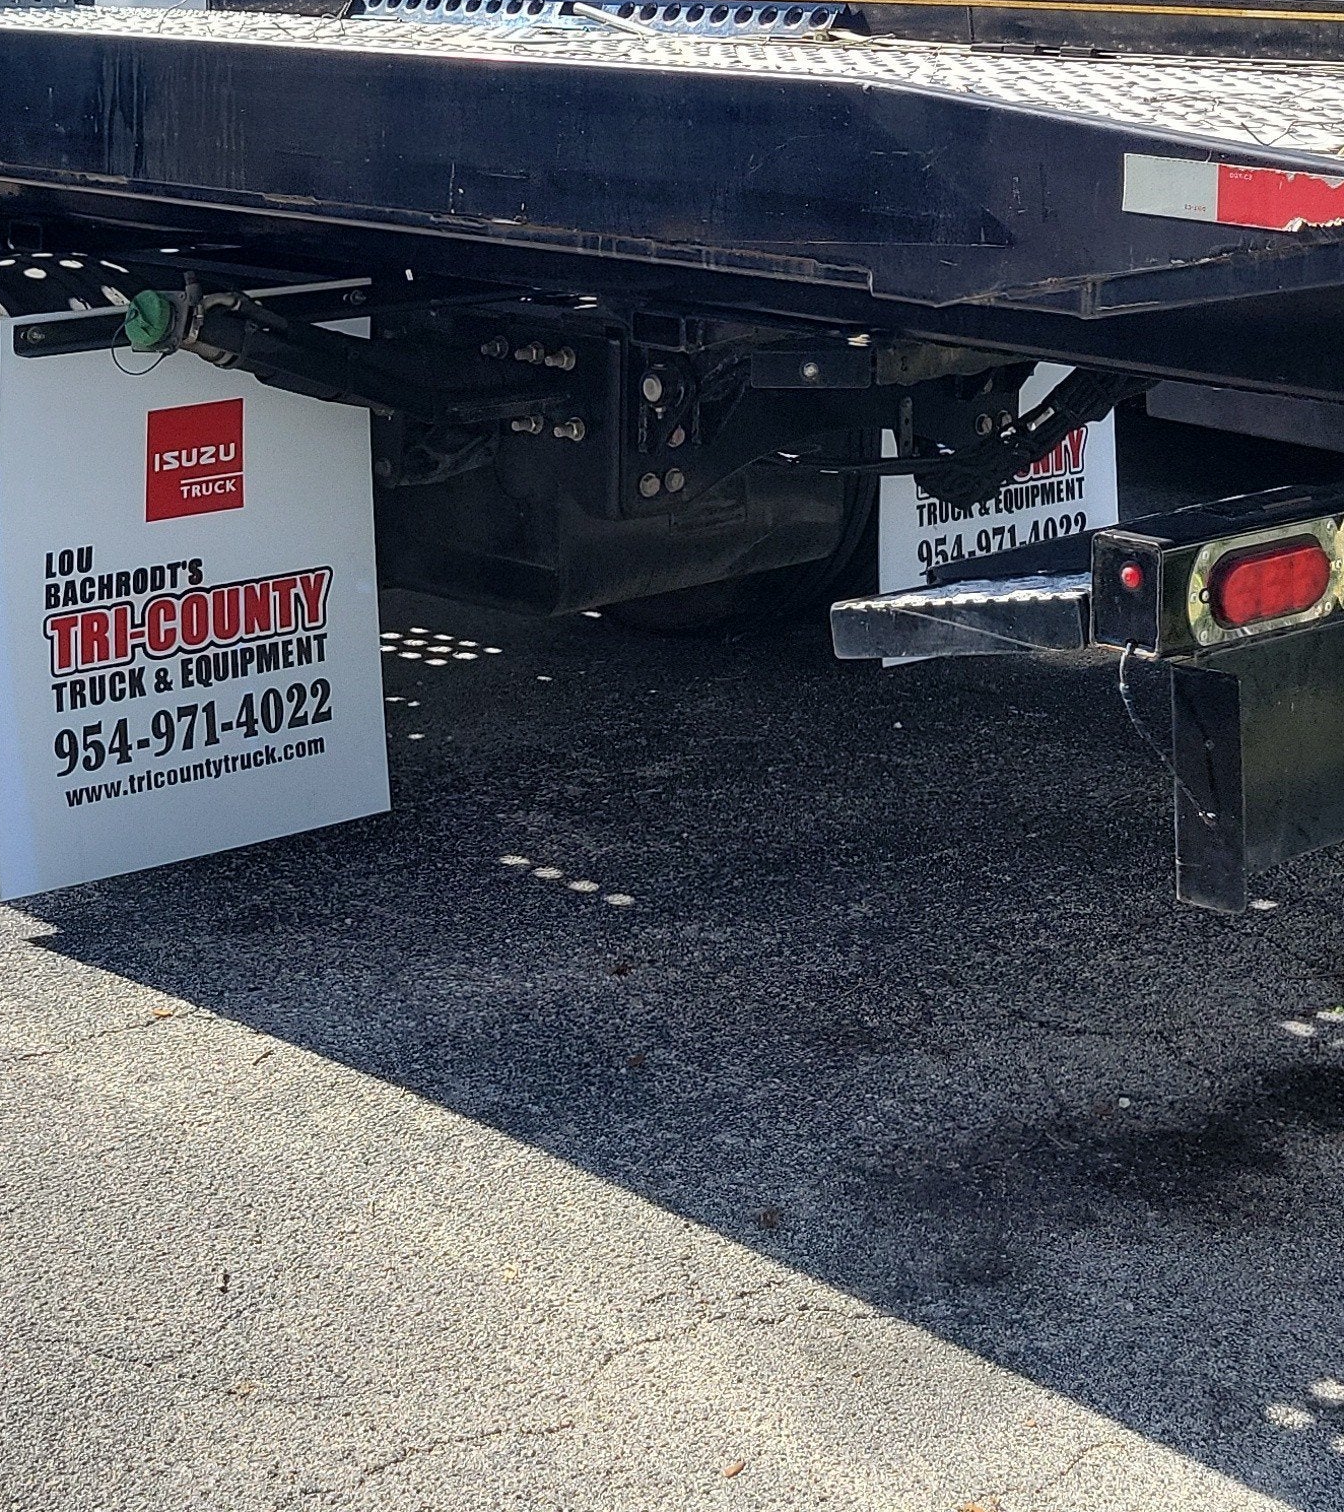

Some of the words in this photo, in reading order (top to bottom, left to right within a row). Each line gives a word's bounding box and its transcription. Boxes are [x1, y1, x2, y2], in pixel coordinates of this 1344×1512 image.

[153, 442, 236, 472] ISUZU
[180, 478, 237, 500] TRUCK
[995, 476, 1085, 514] EQUIPMENT
[44, 558, 204, 610] BACHRODT'S
[45, 546, 94, 579] LOU
[44, 567, 332, 676] TRI-COUNTY
[51, 666, 146, 713] TRUCK
[153, 667, 173, 693] &
[181, 633, 328, 688] EQUIPMENT
[54, 678, 333, 777] 954-971-4022
[65, 735, 325, 808] www.tricountytruck.com
